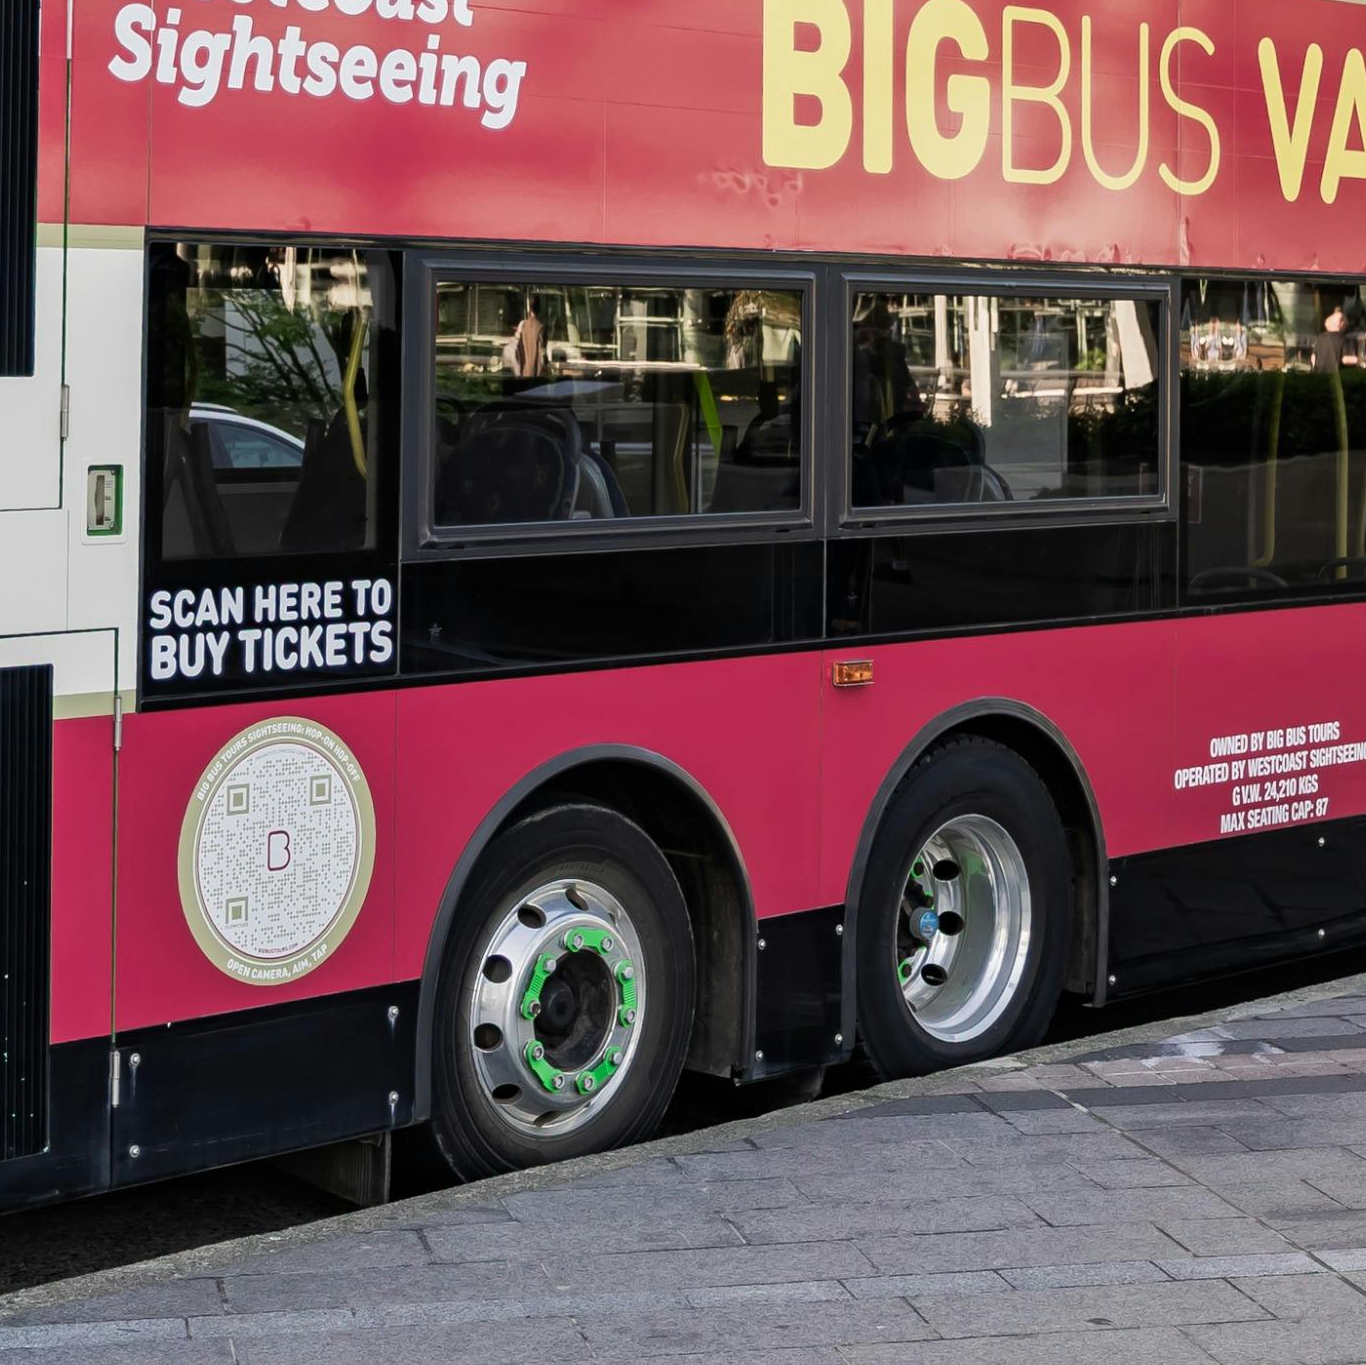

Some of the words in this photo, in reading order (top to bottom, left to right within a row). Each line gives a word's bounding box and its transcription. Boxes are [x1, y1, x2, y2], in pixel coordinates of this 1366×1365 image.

[107, 3, 527, 129] Sightseeing
[150, 586, 243, 630] SCAN
[255, 581, 343, 623] HERE
[351, 578, 392, 618] TO
[151, 631, 230, 680] BUY
[239, 621, 393, 673] TICKETS
[1210, 734, 1248, 758] OWNED
[1250, 732, 1265, 750] BY
[1266, 729, 1283, 748] BIG
[1286, 726, 1306, 745] BUS
[1308, 721, 1340, 743] TOURS
[197, 783, 210, 800] BIG
[208, 764, 223, 781] BUS
[221, 738, 247, 763] TOURS
[247, 723, 305, 742] SIGHTSEEING:
[305, 728, 335, 750] HOP-ON
[334, 745, 361, 781] HOP-OFF
[1174, 762, 1229, 789] OPERATED
[1231, 761, 1246, 781] BY
[1247, 750, 1308, 778] WESTCOAST
[1264, 778, 1297, 802] 24,210
[1299, 774, 1319, 795] KGS
[1220, 812, 1245, 834] MAX
[1247, 804, 1289, 830] SEATING
[1291, 801, 1314, 823] CAP:
[1316, 797, 1329, 817] 87
[227, 959, 251, 977] OPEN
[251, 967, 291, 979] CAMERA,
[292, 959, 312, 975] AIM,
[311, 943, 328, 961] TAP
